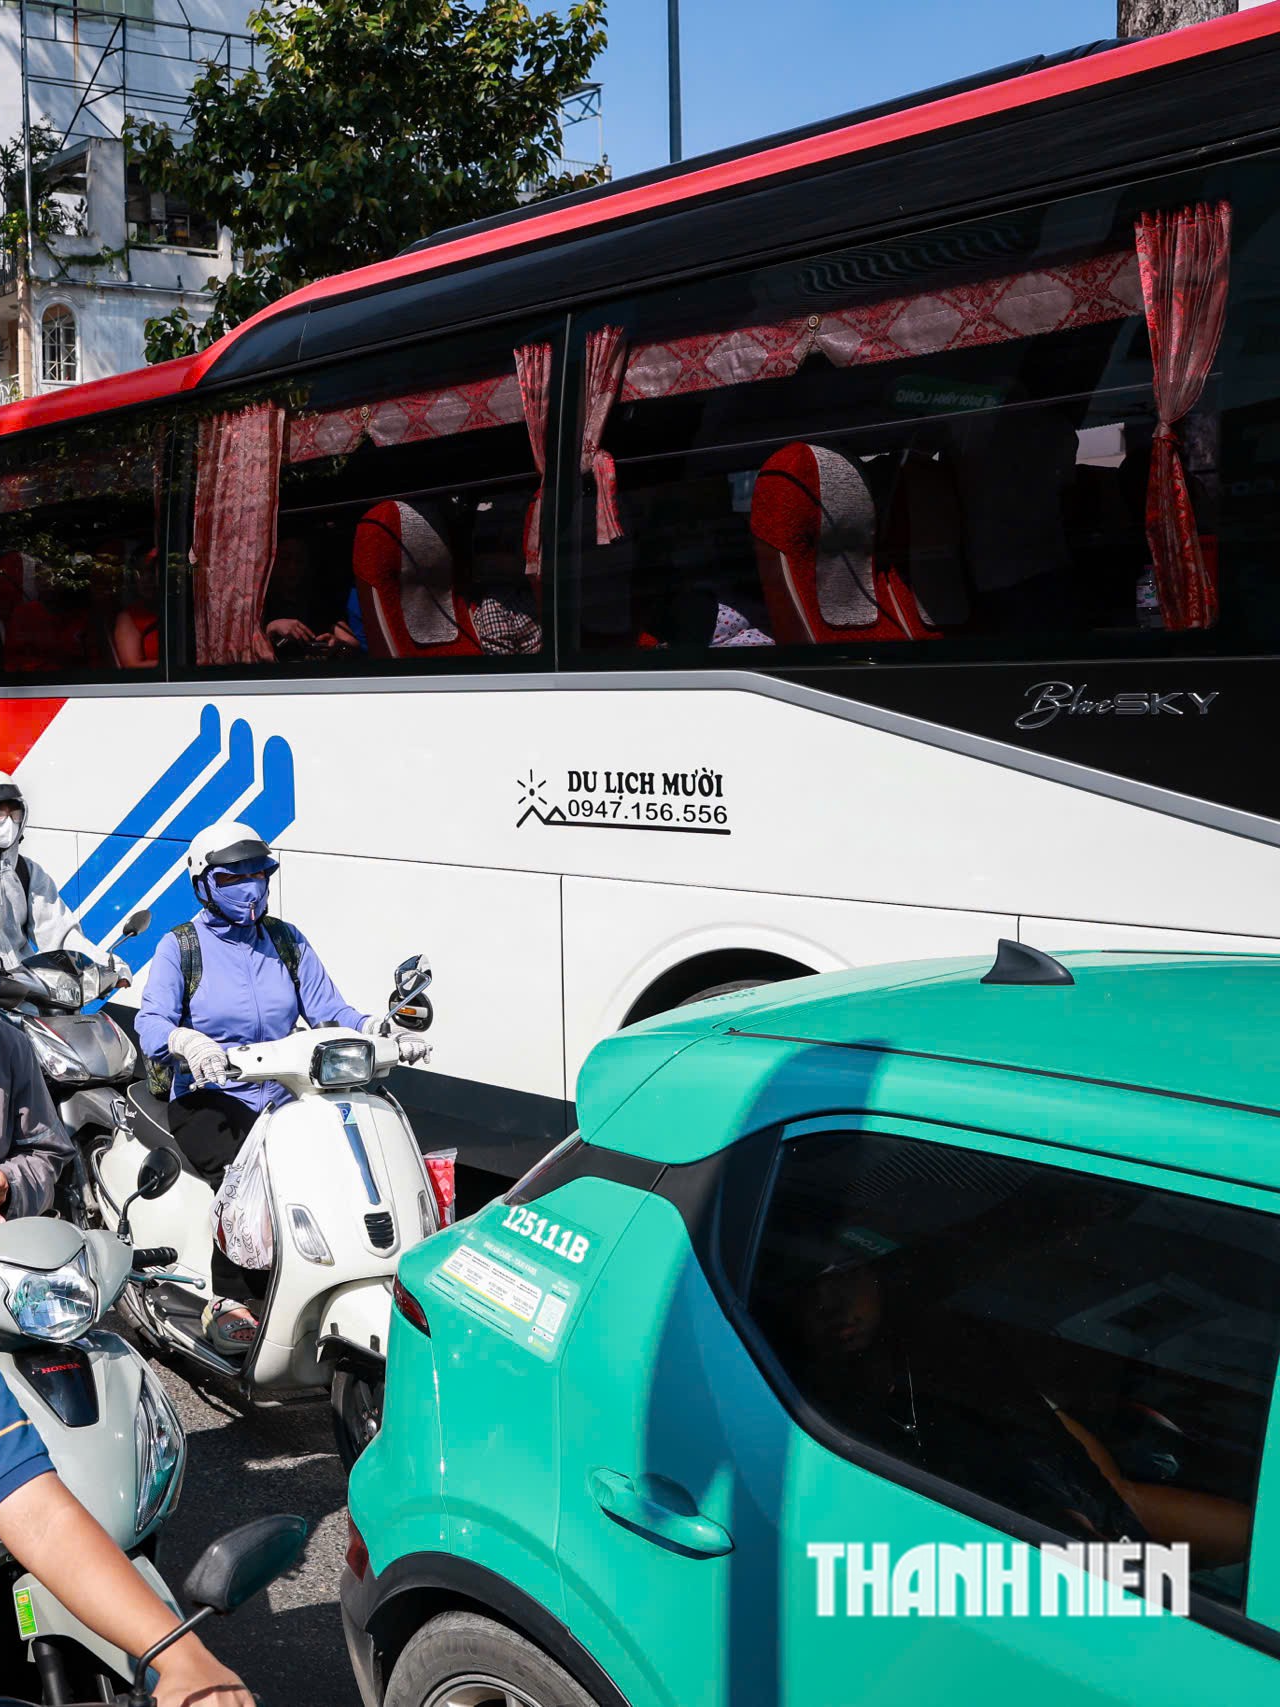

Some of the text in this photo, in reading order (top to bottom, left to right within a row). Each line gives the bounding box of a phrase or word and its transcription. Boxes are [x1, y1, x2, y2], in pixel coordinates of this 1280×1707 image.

[567, 767, 723, 800] DU LỊCH MƯỜI
[568, 799, 728, 824] 0947.156.556
[502, 1205, 590, 1264] 125111B
[41, 1363, 80, 1375] HONDA
